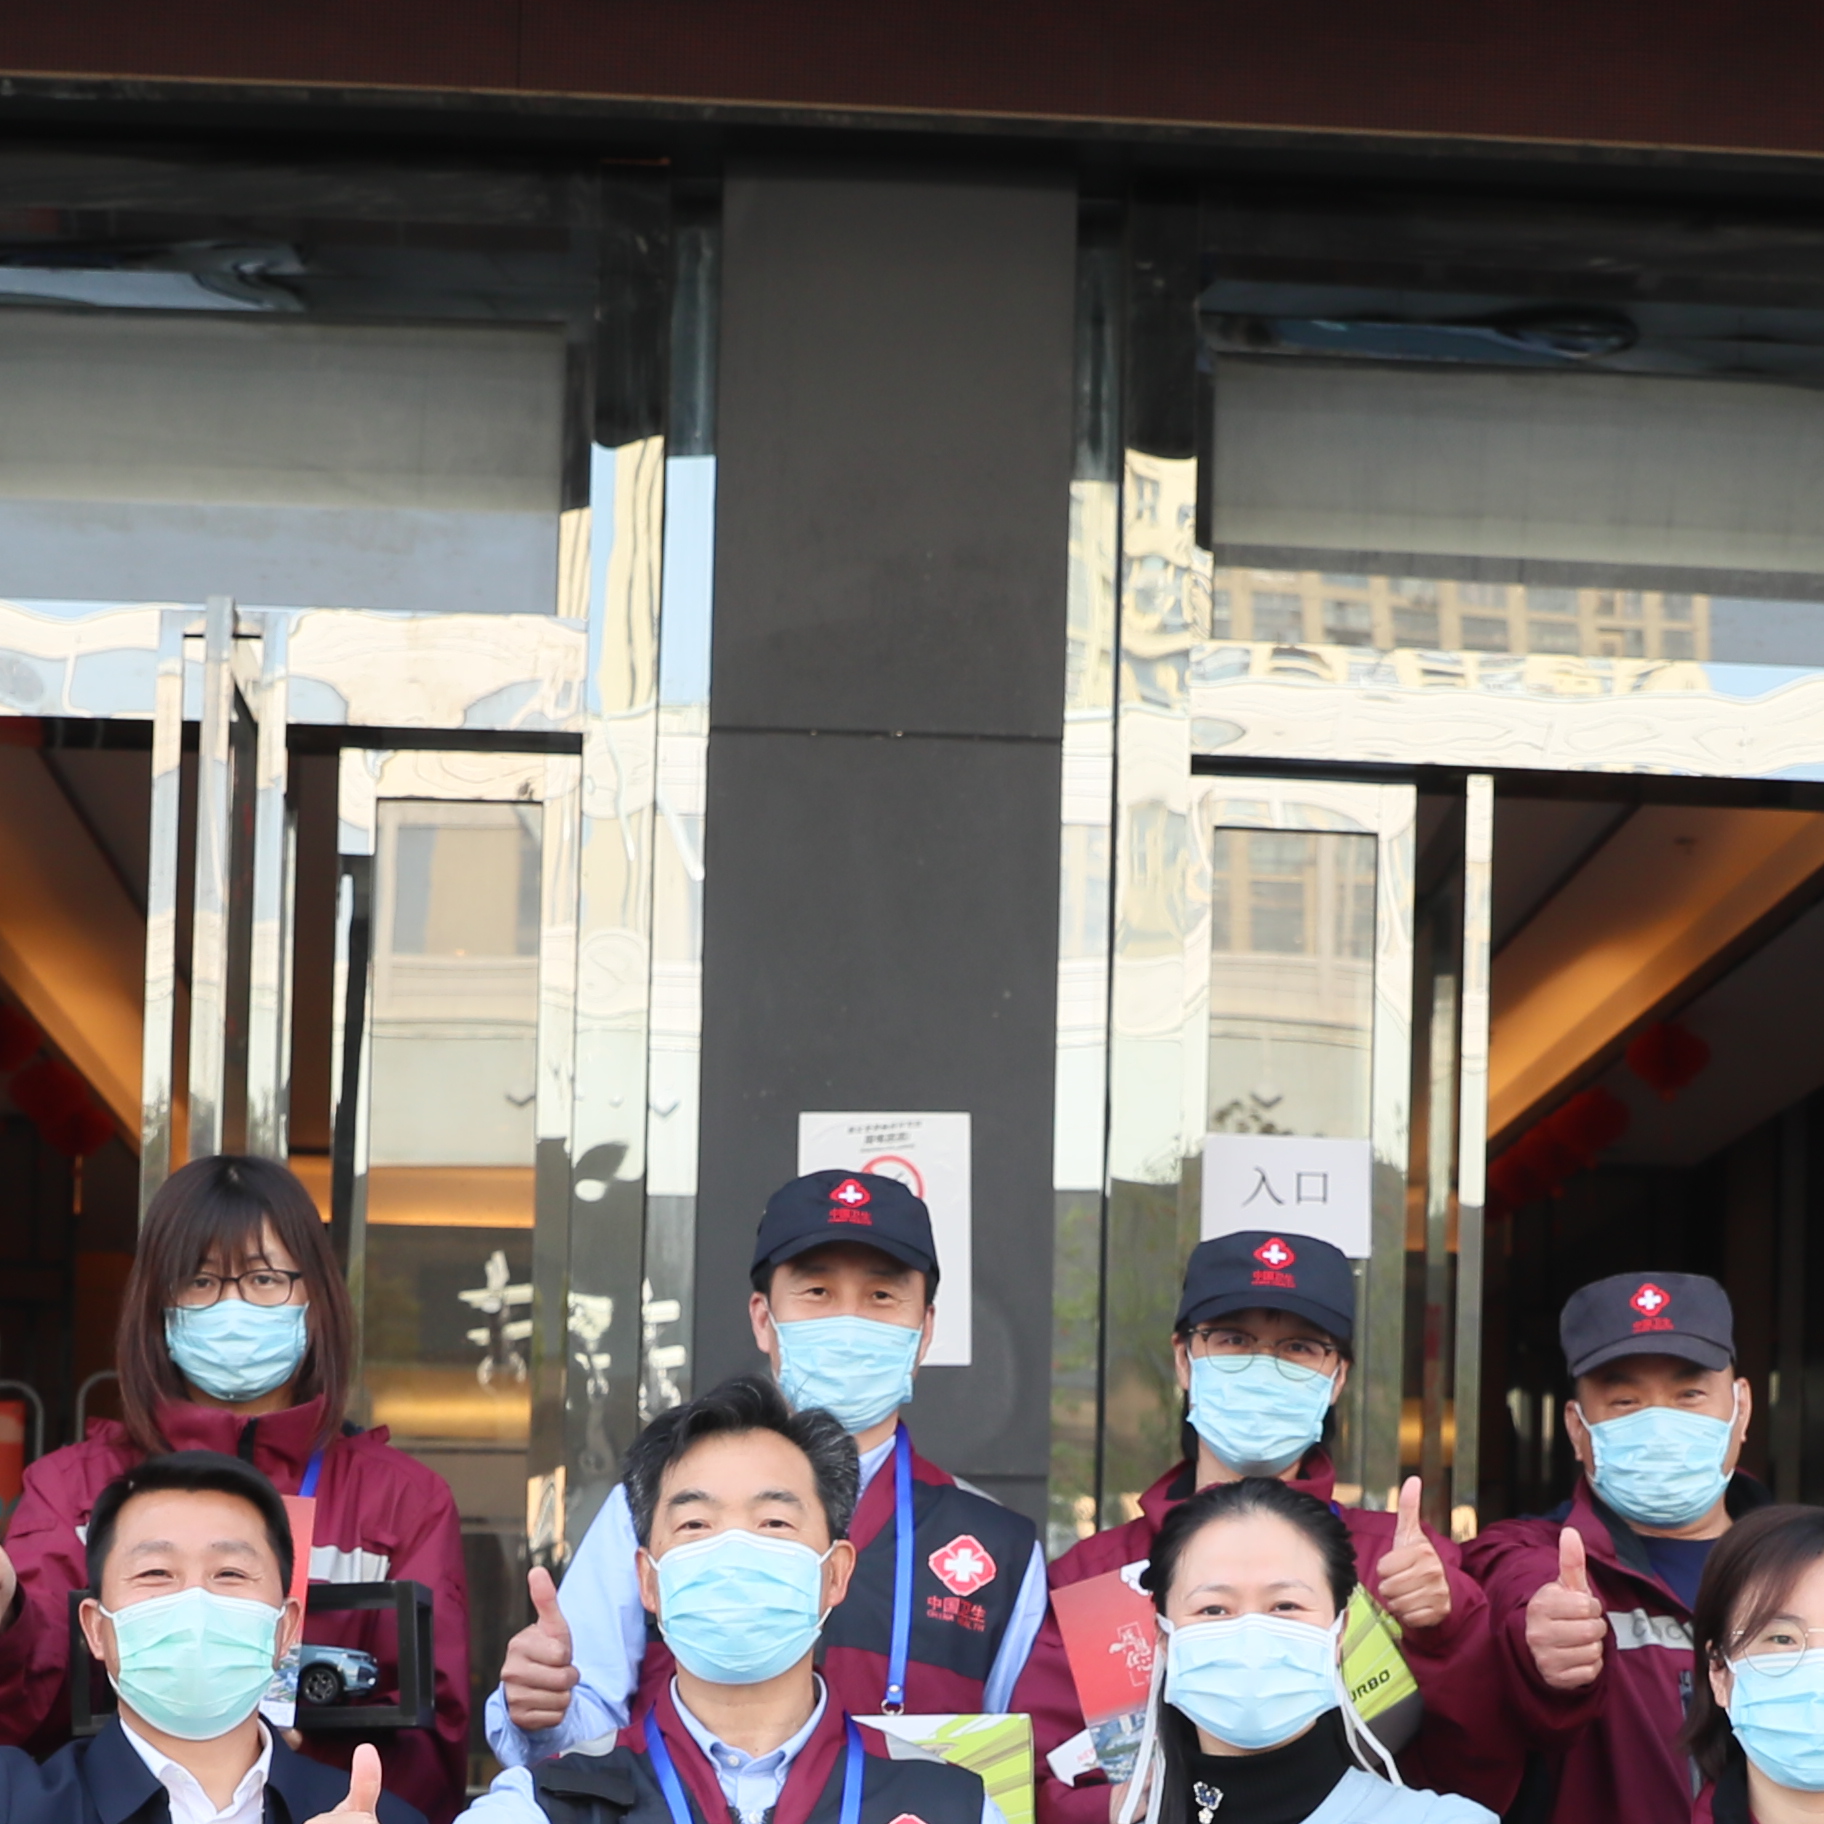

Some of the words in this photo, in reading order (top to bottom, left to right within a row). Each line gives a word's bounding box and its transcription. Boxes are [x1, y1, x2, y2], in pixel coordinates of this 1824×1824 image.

[1242, 1166, 1330, 1208] 入口
[926, 1595, 986, 1624] 中国卫生
[1350, 1668, 1391, 1702] URBO
